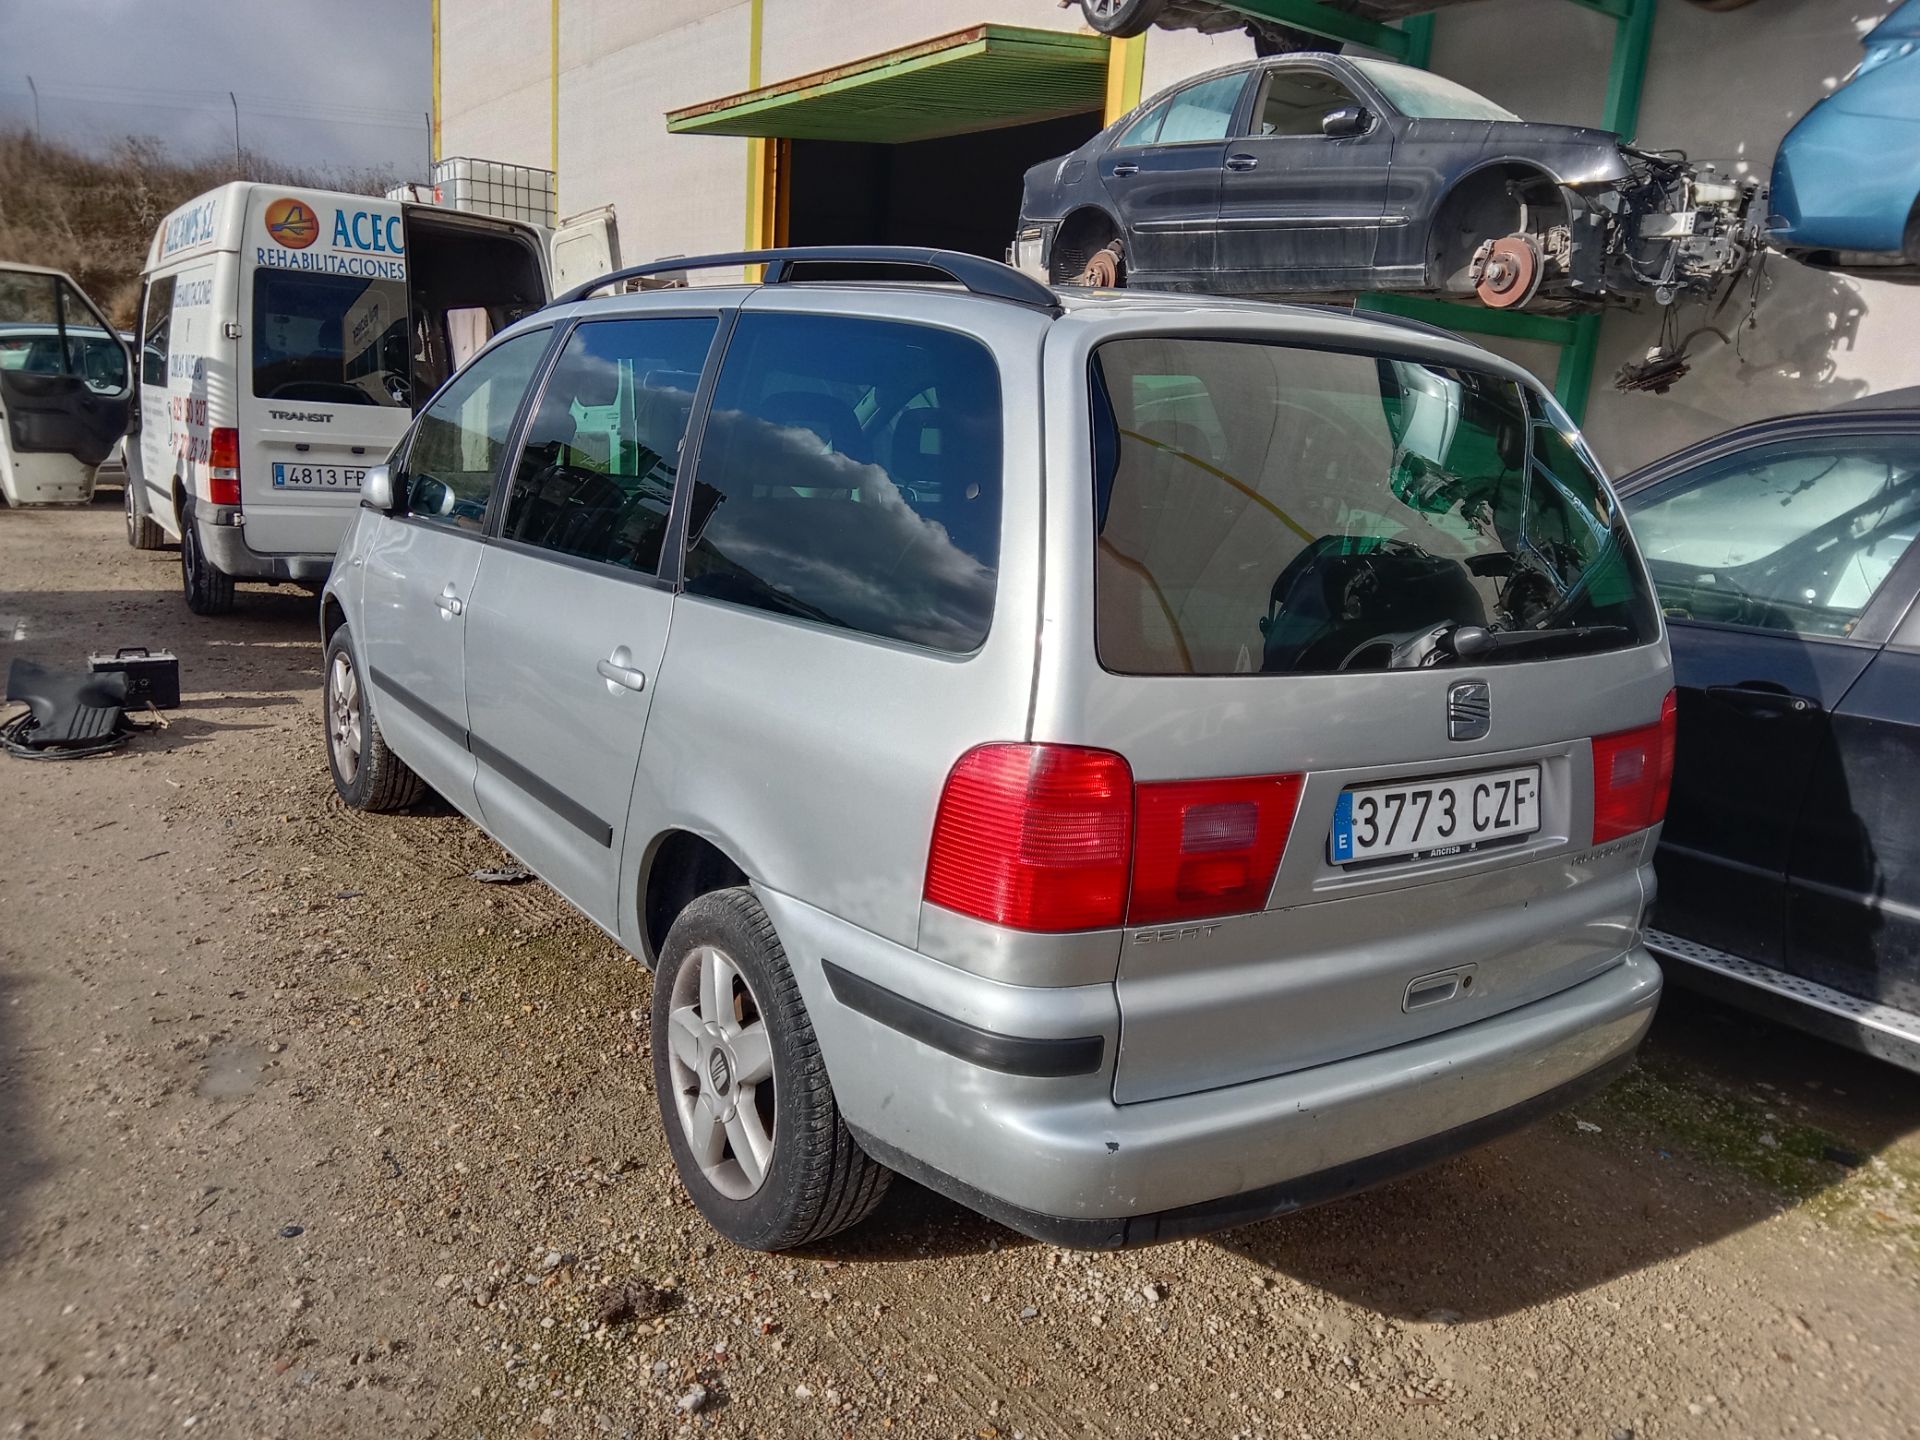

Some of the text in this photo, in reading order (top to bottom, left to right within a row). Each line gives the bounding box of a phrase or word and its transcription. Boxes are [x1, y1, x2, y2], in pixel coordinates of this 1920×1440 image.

[331, 208, 405, 255] ACEC
[256, 247, 405, 280] REHABILITACIONES
[269, 410, 334, 423] TRANSIT
[289, 467, 337, 486] 4813
[1356, 777, 1531, 848] 3773 CZF
[1338, 833, 1348, 849] E
[1430, 840, 1461, 857] Ancrisa
[1133, 923, 1223, 945] SEAT
